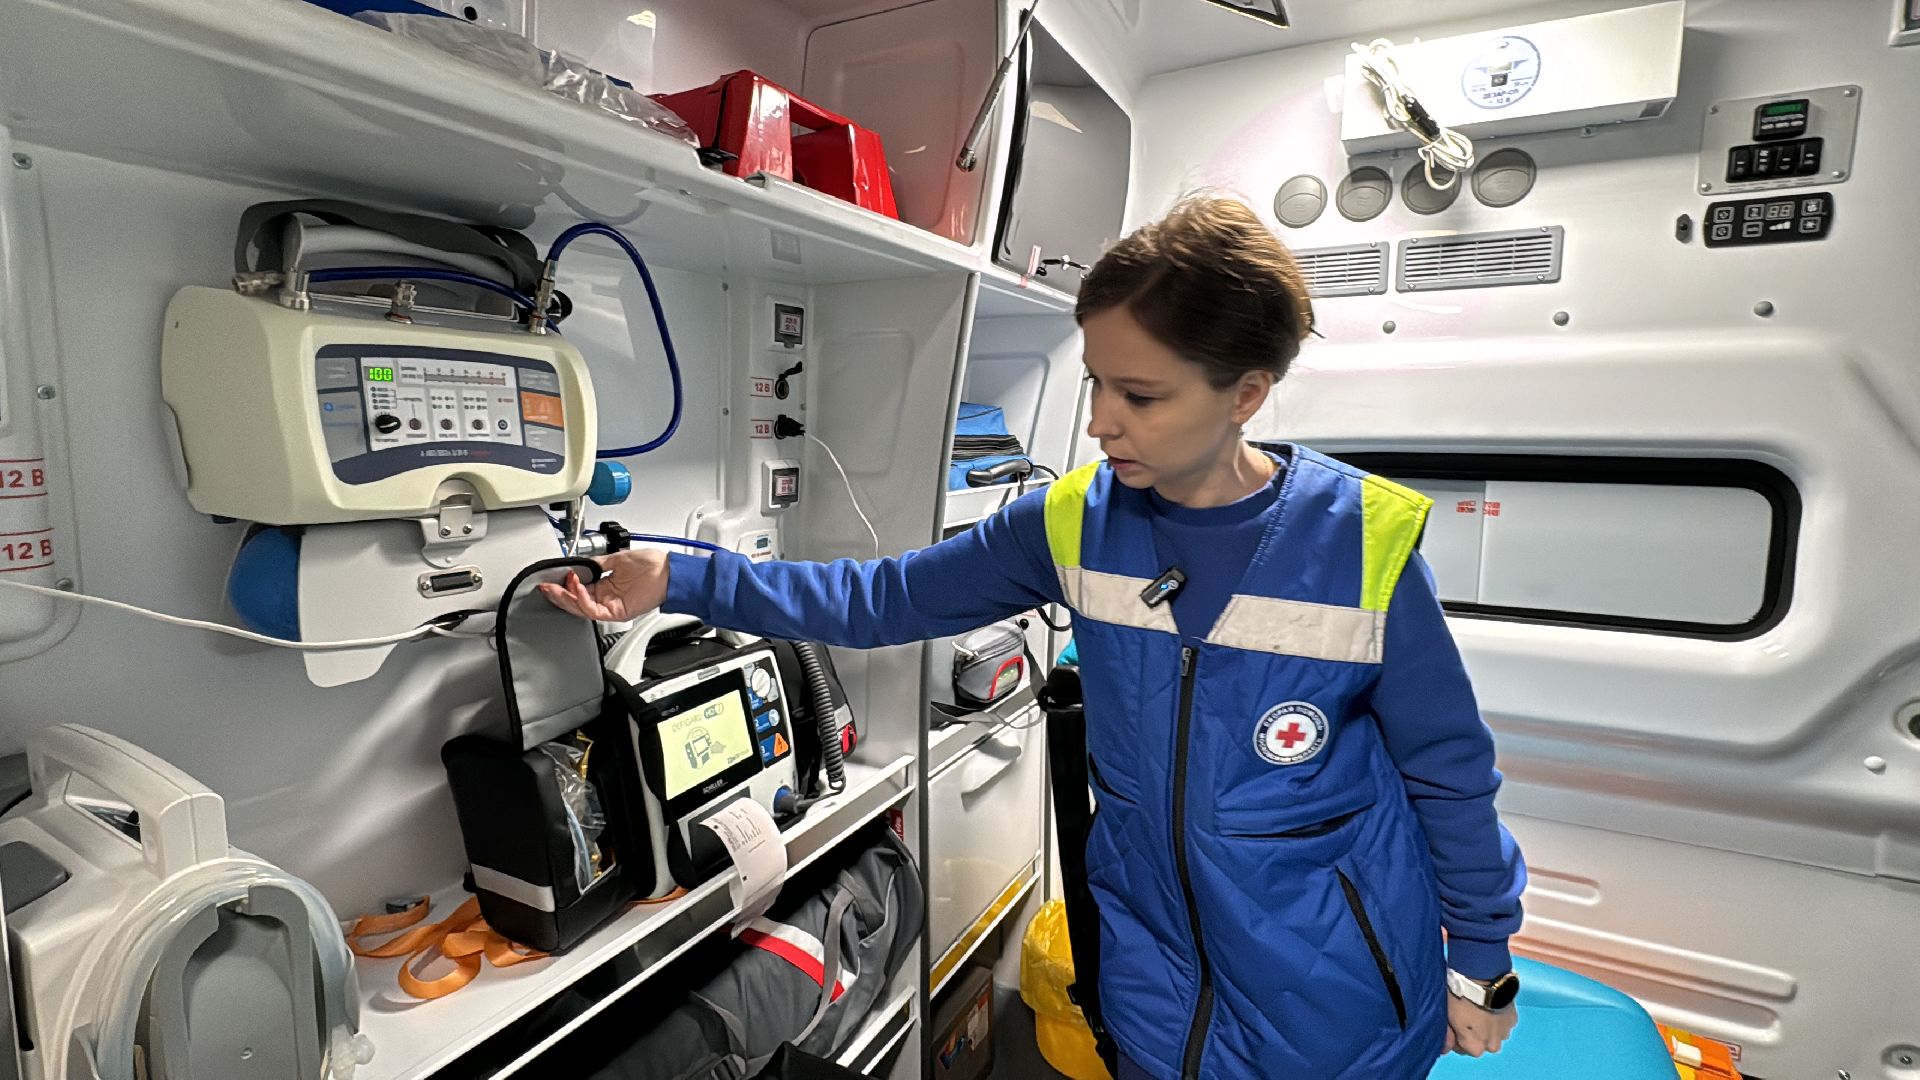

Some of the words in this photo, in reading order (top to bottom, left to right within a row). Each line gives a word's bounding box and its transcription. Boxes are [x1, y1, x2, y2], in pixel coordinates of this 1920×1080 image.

[369, 367, 393, 381] 100
[755, 383, 764, 392] 12
[755, 424, 764, 434] 12
[764, 424, 770, 434] В
[0, 469, 24, 489] 12
[31, 468, 44, 487] В
[2, 542, 34, 561] 12
[40, 539, 52, 557] В
